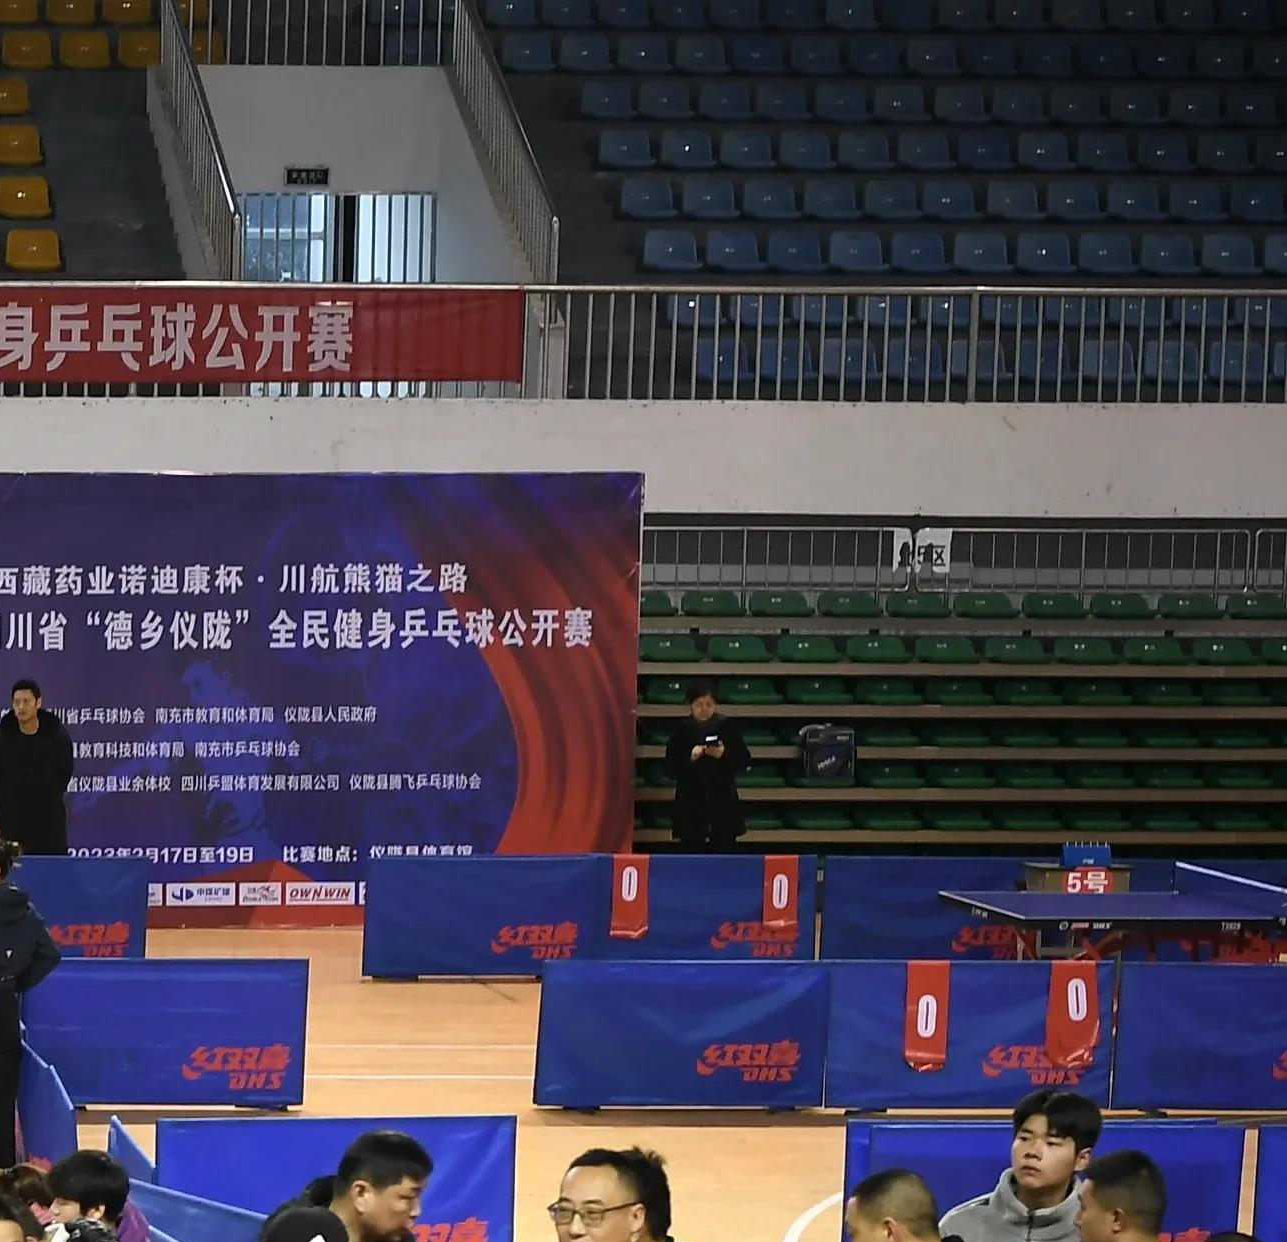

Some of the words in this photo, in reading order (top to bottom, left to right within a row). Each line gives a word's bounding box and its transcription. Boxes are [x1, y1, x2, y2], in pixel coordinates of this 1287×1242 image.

[156, 707, 274, 725] 南充市教育和体育局
[284, 706, 377, 723] 仪陇县人民政府
[195, 741, 300, 759] 南充市乒乓球协会
[181, 775, 339, 793] 四川乒盟体育发展有限公司
[349, 773, 481, 791] 仪陇县腾飞乒乓球协会
[622, 865, 638, 902] 0
[772, 873, 788, 909] 0
[1067, 871, 1108, 894] 5号
[1067, 977, 1087, 1022] 0
[916, 994, 937, 1039] 0
